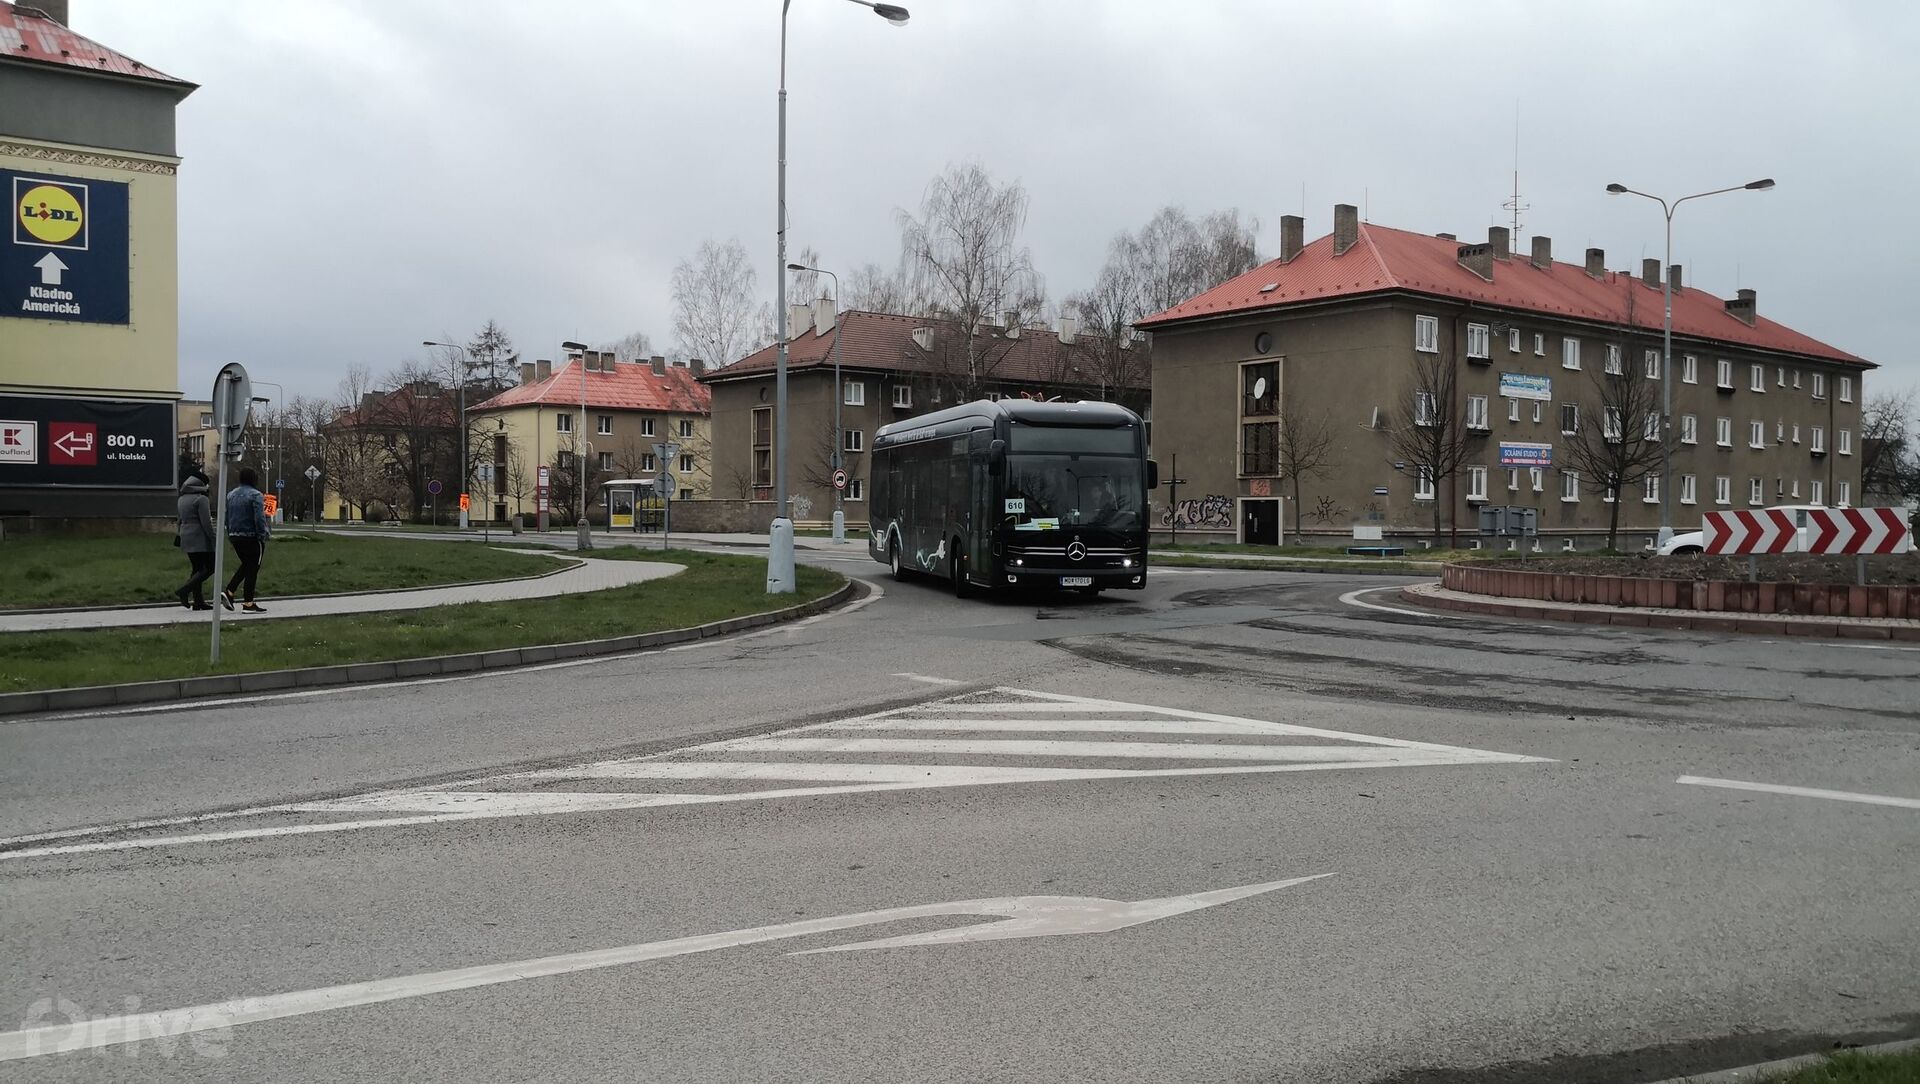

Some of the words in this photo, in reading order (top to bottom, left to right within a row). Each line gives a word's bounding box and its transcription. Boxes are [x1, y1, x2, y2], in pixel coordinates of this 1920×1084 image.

[30, 286, 73, 301] Kladno
[22, 299, 81, 315] Americká
[107, 434, 136, 448] 800
[140, 437, 154, 448] m
[119, 453, 147, 461] Italská
[1523, 449, 1538, 458] STUDIO
[1008, 502, 1023, 510] 610
